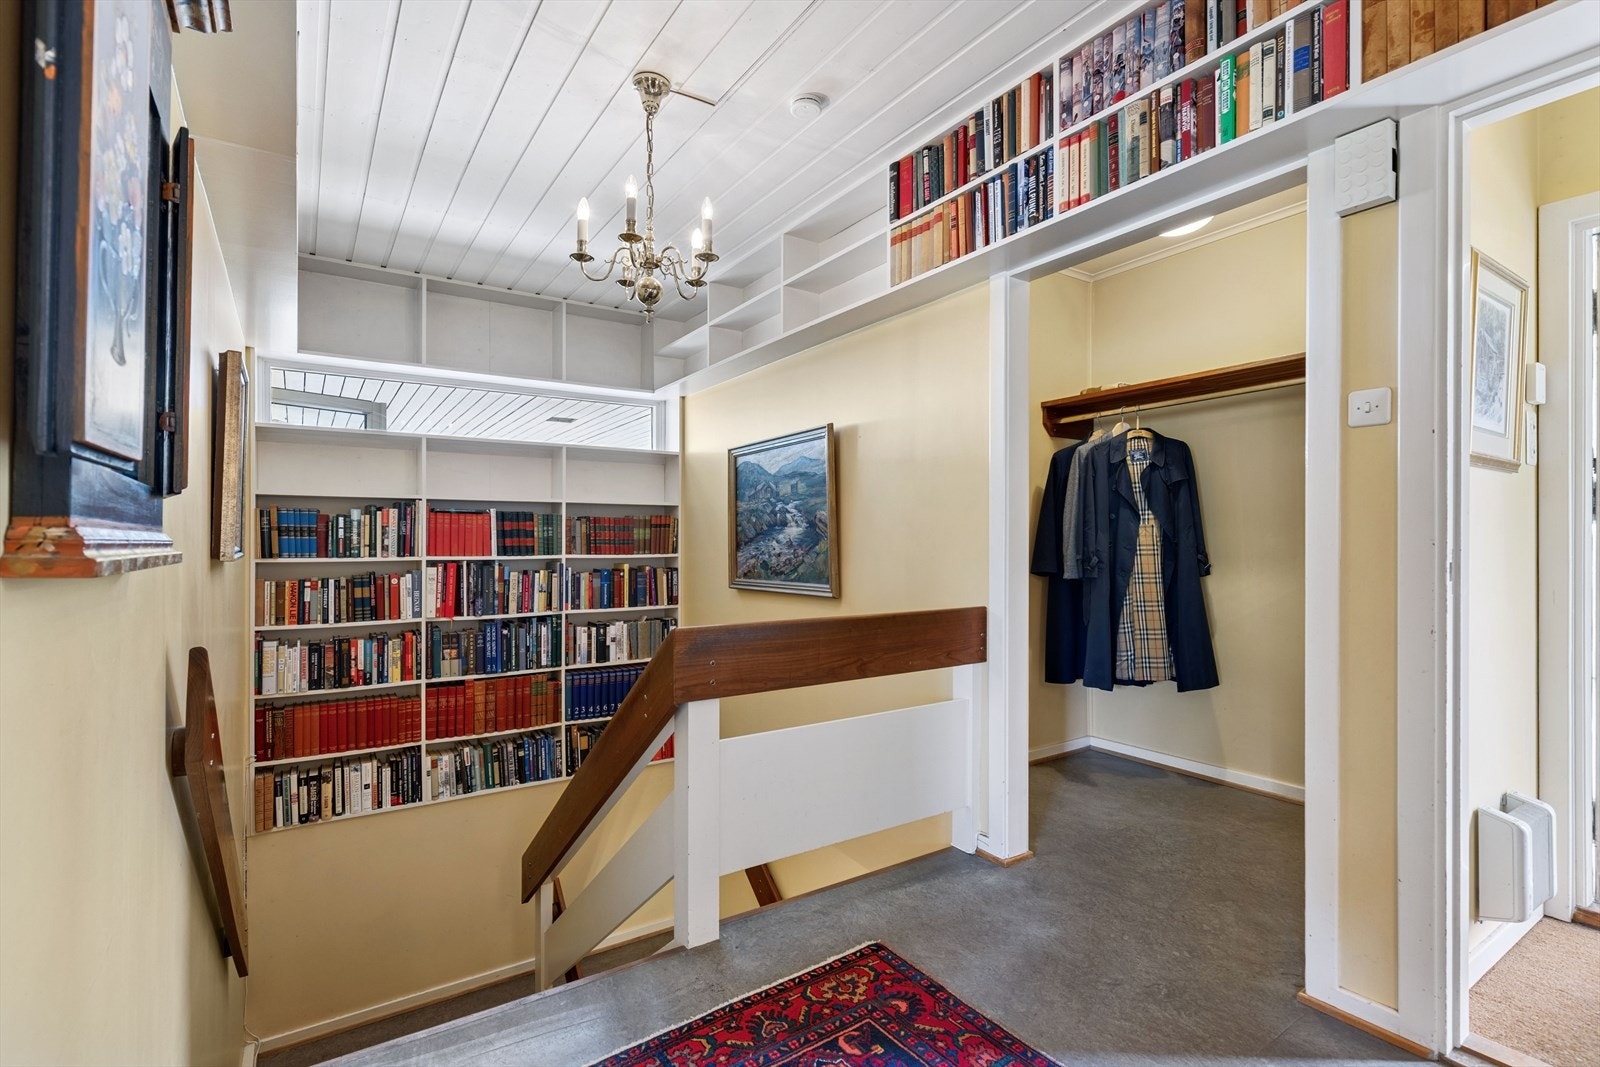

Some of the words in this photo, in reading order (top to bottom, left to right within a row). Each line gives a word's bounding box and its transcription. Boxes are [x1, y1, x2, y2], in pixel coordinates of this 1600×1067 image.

[1028, 175, 1036, 218] NULLPUNKT
[290, 581, 298, 609] HAAKON
[290, 610, 298, 621] LIE
